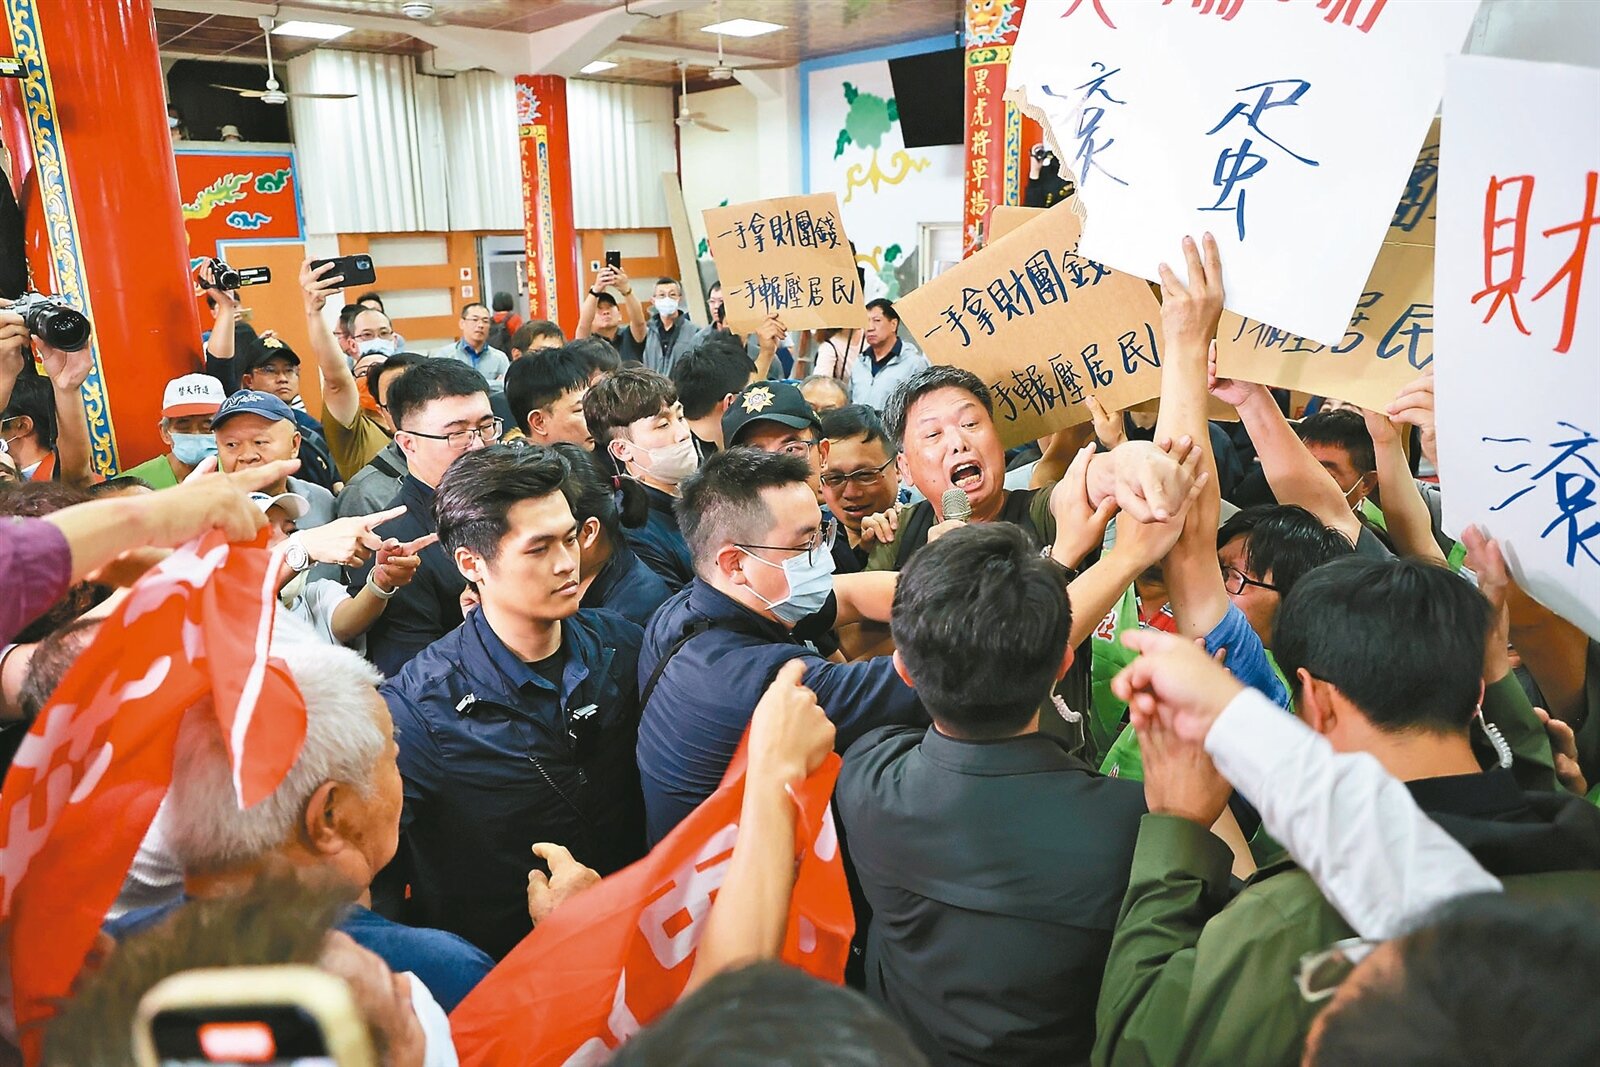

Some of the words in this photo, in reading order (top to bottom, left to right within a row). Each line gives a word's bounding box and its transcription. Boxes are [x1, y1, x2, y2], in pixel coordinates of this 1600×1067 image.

[969, 67, 993, 242] 黑虎將軍揚
[1041, 62, 1320, 242] 滾蛋
[717, 209, 842, 252] 一手拿財團錢
[730, 272, 855, 314] 一手輾壓居民
